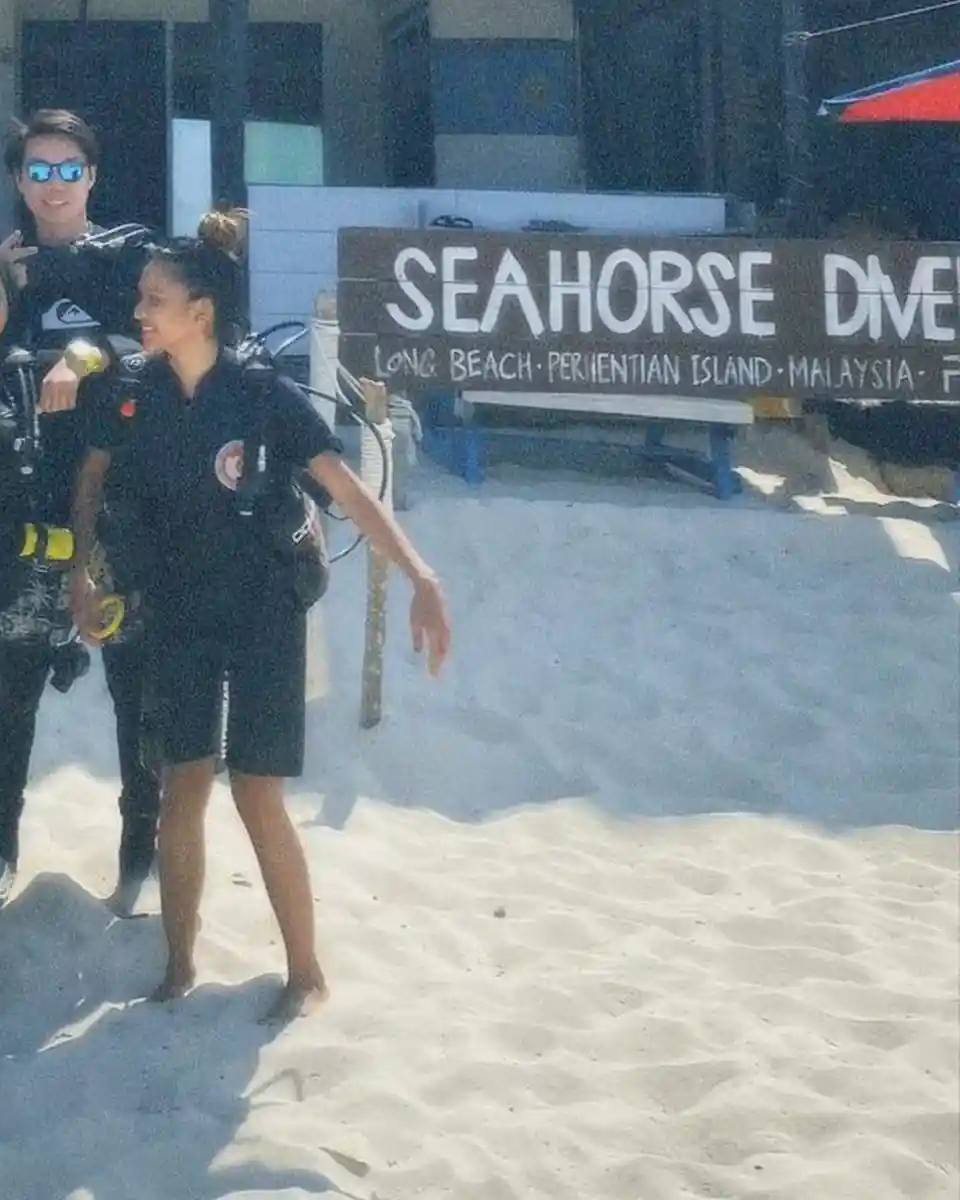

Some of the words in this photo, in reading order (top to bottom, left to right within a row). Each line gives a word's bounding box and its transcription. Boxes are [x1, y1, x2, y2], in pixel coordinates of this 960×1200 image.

[385, 246, 777, 339] SEAHORSE
[823, 253, 960, 343] DIVE
[374, 344, 437, 378] LONG
[449, 348, 533, 382] BEACH
[548, 351, 680, 385] PERHENTIAN
[691, 353, 772, 386] ISLAND
[789, 354, 914, 390] MALAYSIA
